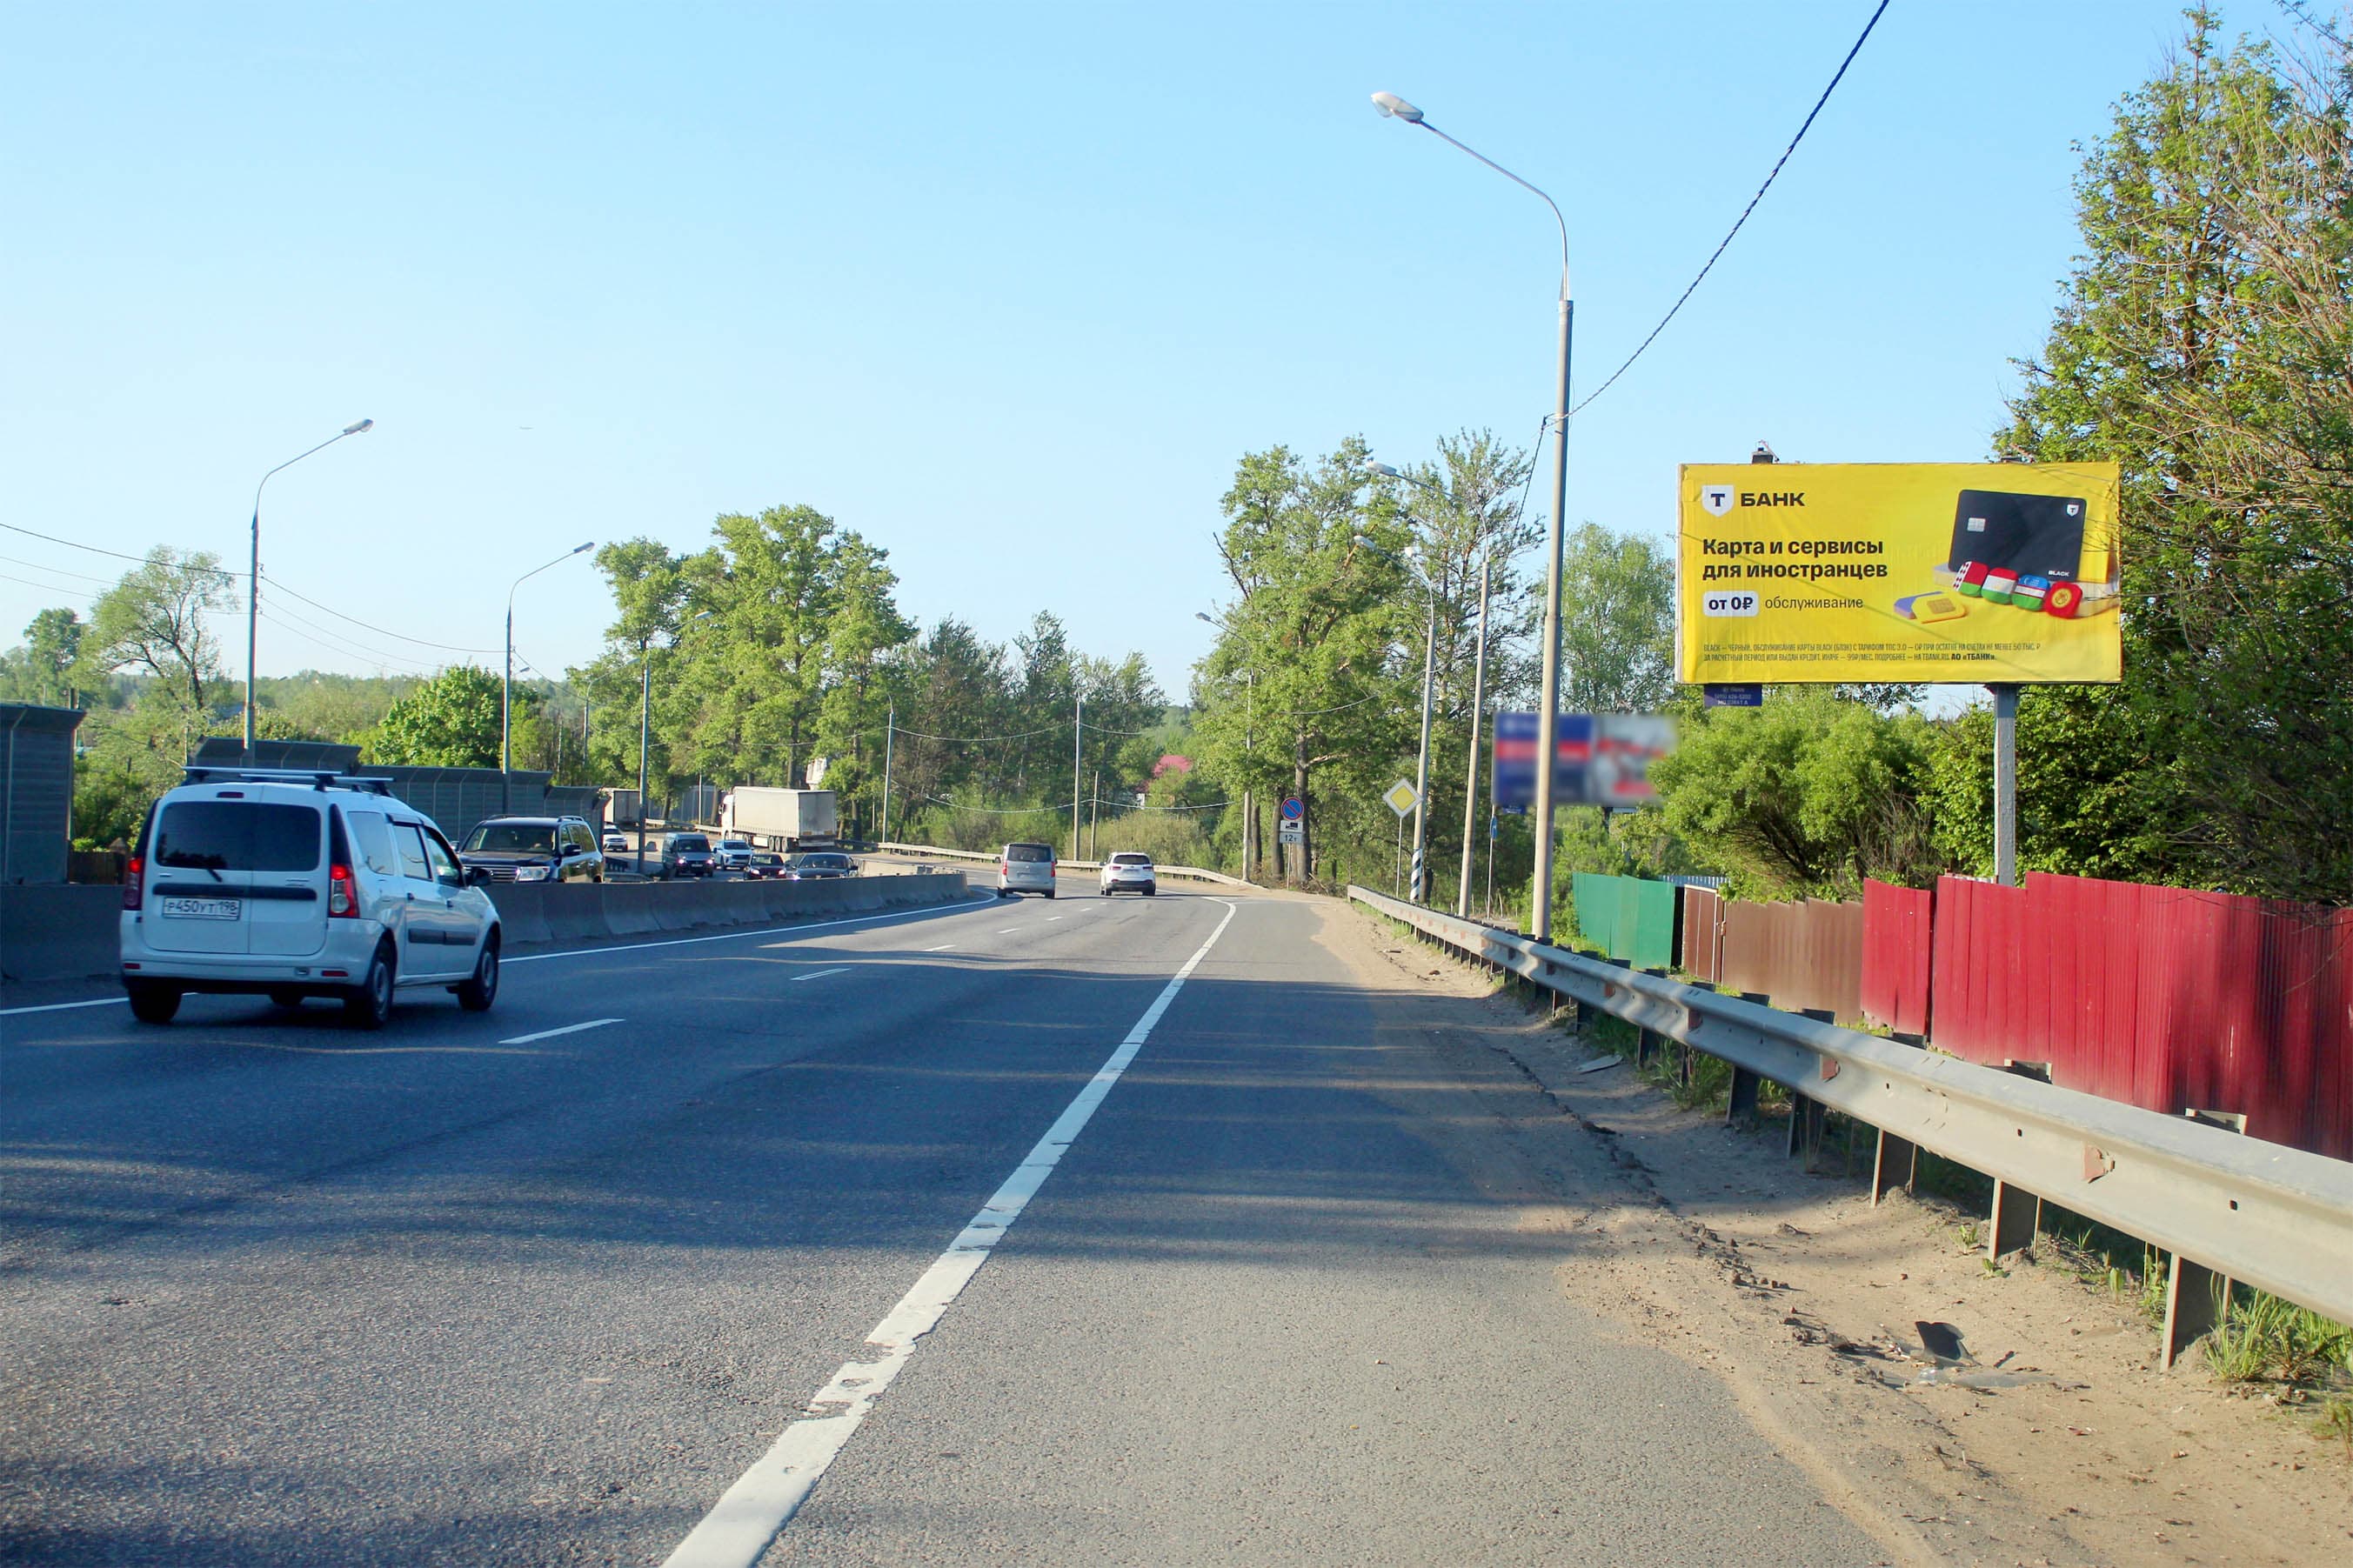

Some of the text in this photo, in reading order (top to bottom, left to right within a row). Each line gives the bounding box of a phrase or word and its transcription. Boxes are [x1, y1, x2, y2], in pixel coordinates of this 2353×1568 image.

[1741, 492, 1805, 507] БАНК
[1702, 538, 1883, 558] Карта и сервисы
[1702, 564, 1888, 581] для иностранцев
[1708, 600, 1727, 610] от
[1765, 596, 1863, 611] обслуживание
